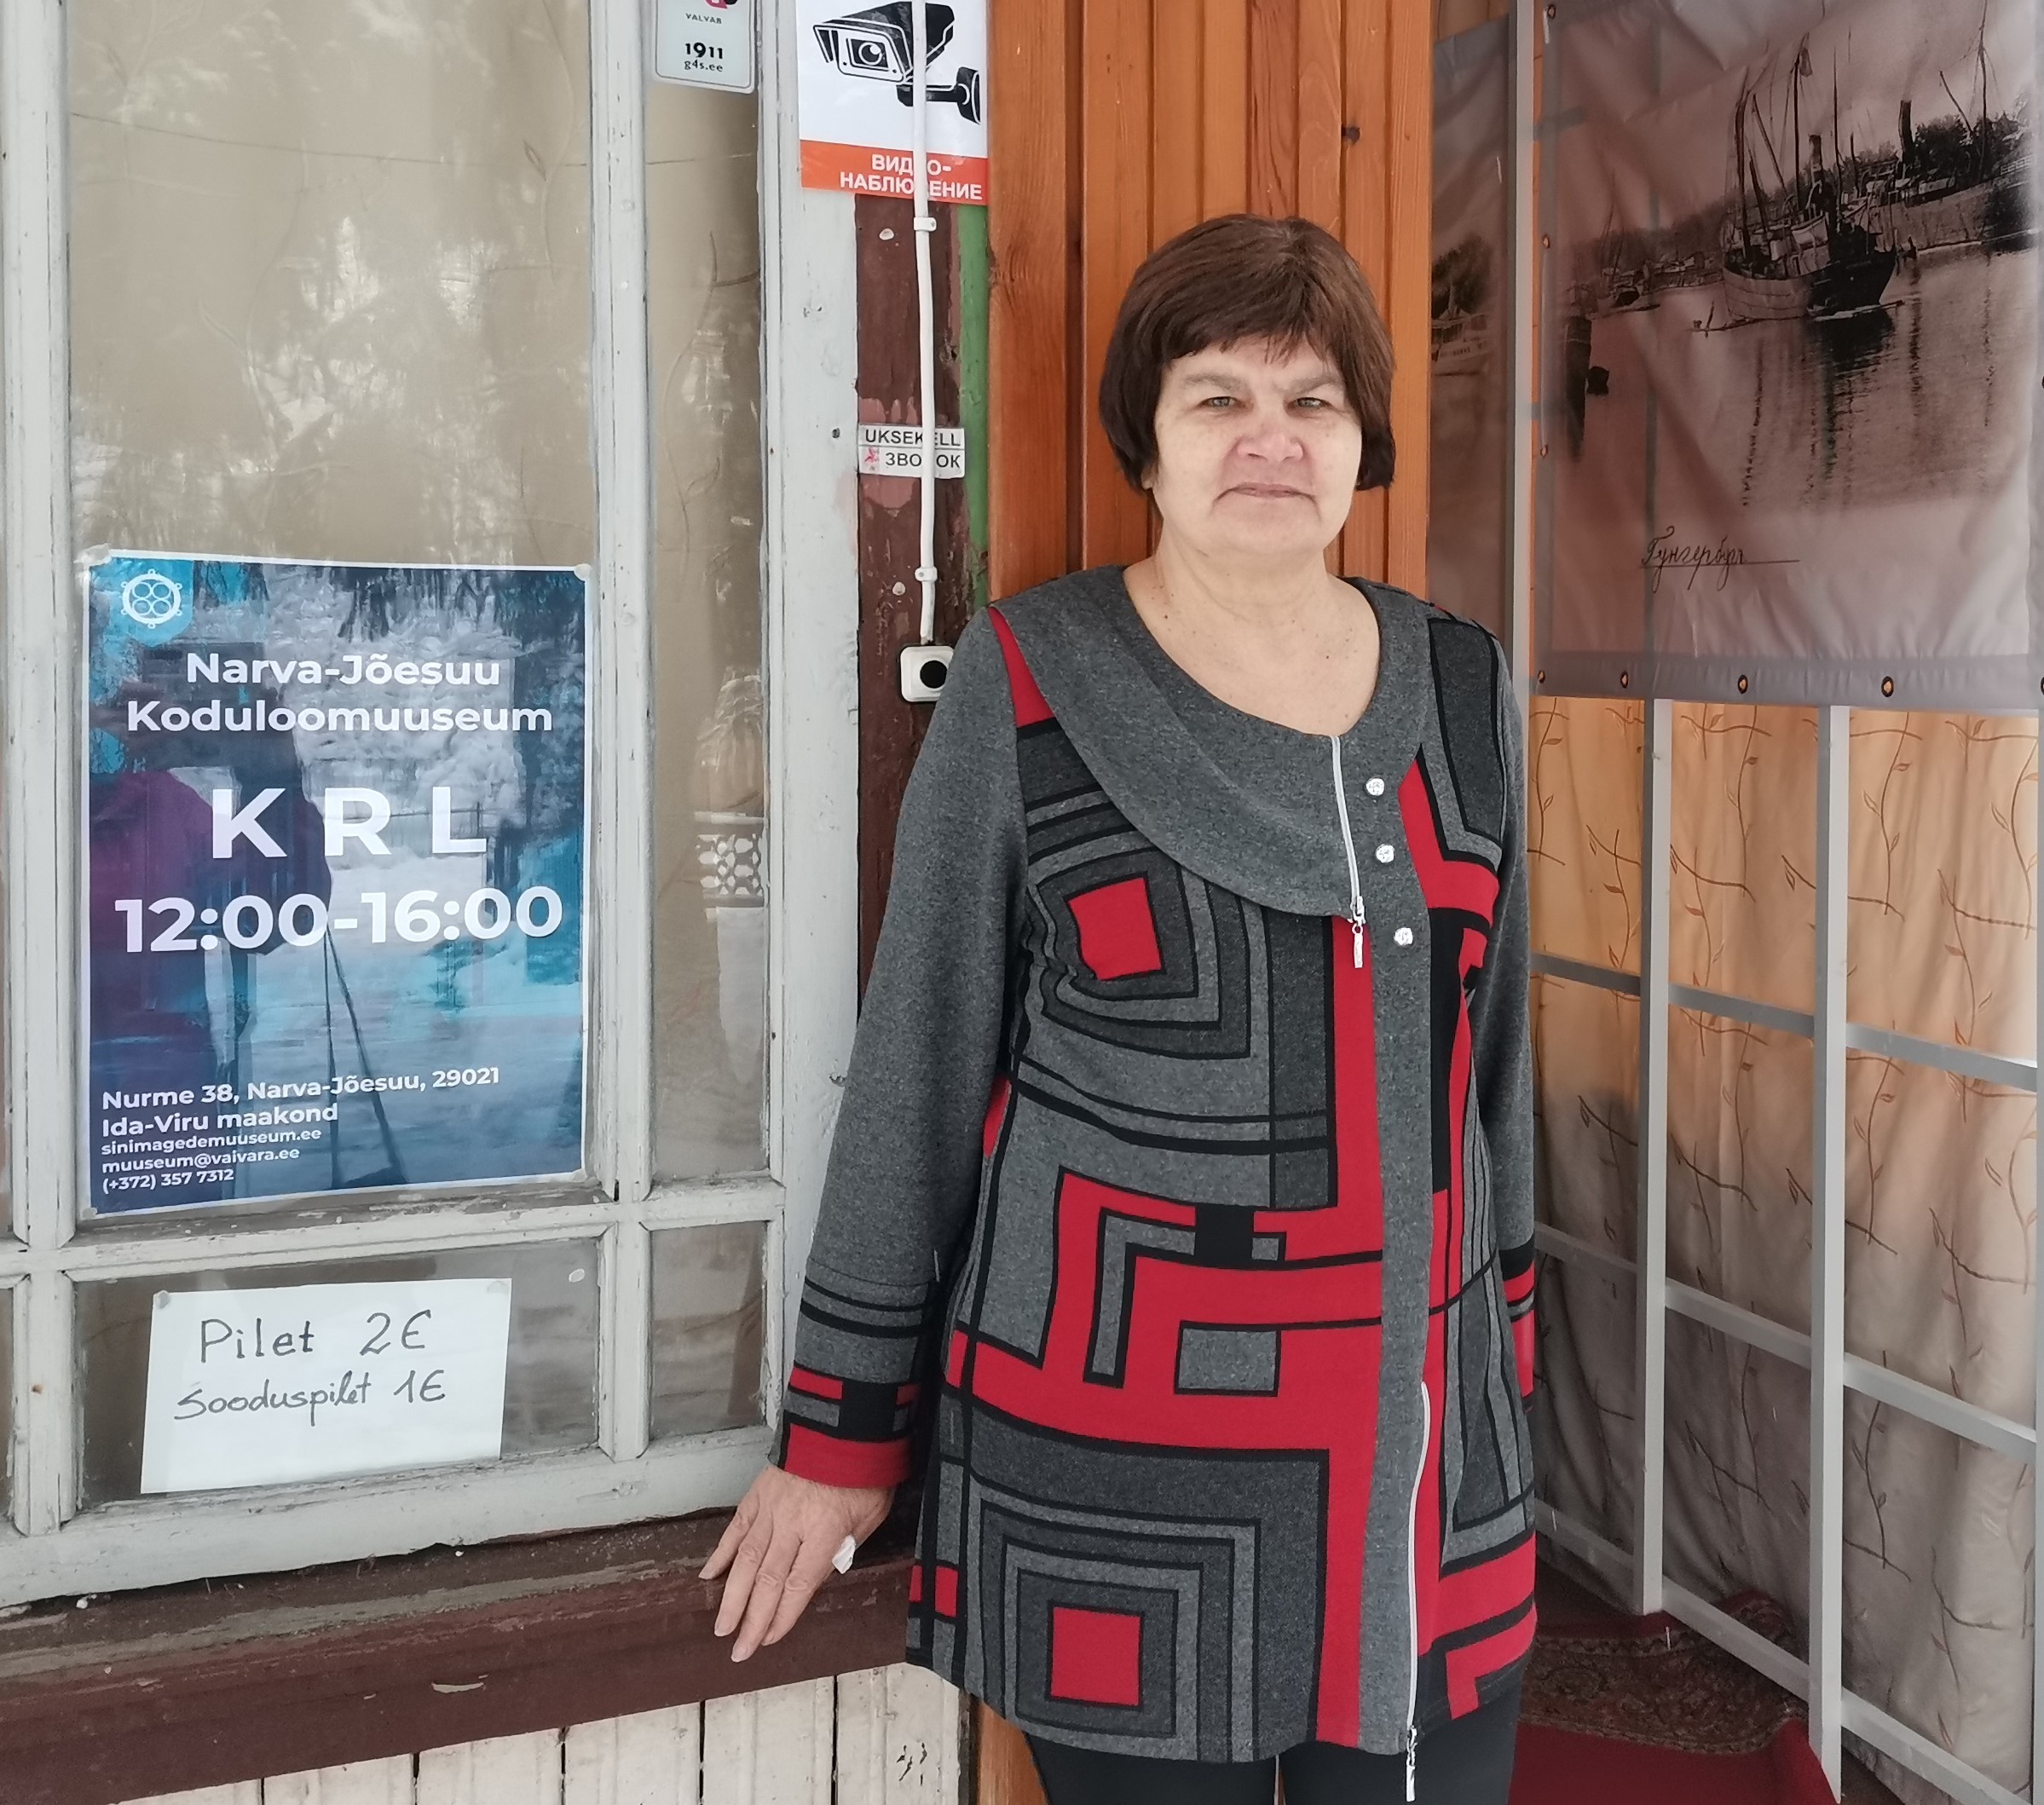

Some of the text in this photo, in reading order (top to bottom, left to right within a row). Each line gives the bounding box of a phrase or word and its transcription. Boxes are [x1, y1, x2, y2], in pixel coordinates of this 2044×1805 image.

[684, 42, 724, 60] 1911
[684, 59, 724, 72] g4s.ee
[870, 153, 953, 176] ВИДО-
[839, 170, 983, 200] НАБЛЮЕНИЕ
[885, 452, 961, 469] ЗВООК
[186, 651, 501, 686] Narva-Jõesuu
[126, 699, 554, 732] Koduloomuuseum
[211, 786, 488, 860] K R L
[114, 885, 563, 954] 12:00-16:00
[102, 1066, 500, 1110] Nurme 38, Narva-Jõesuu, 29021
[102, 1102, 339, 1138] Ida-Viru maakond
[101, 1128, 323, 1156] sinimagedemuuseum.ee
[101, 1148, 301, 1174] muuseum@vaivara.ee
[102, 1168, 235, 1195] (+372) 357 7312
[200, 1309, 432, 1364] Pilet 2€
[174, 1369, 447, 1427] Sooduspilet 1€
